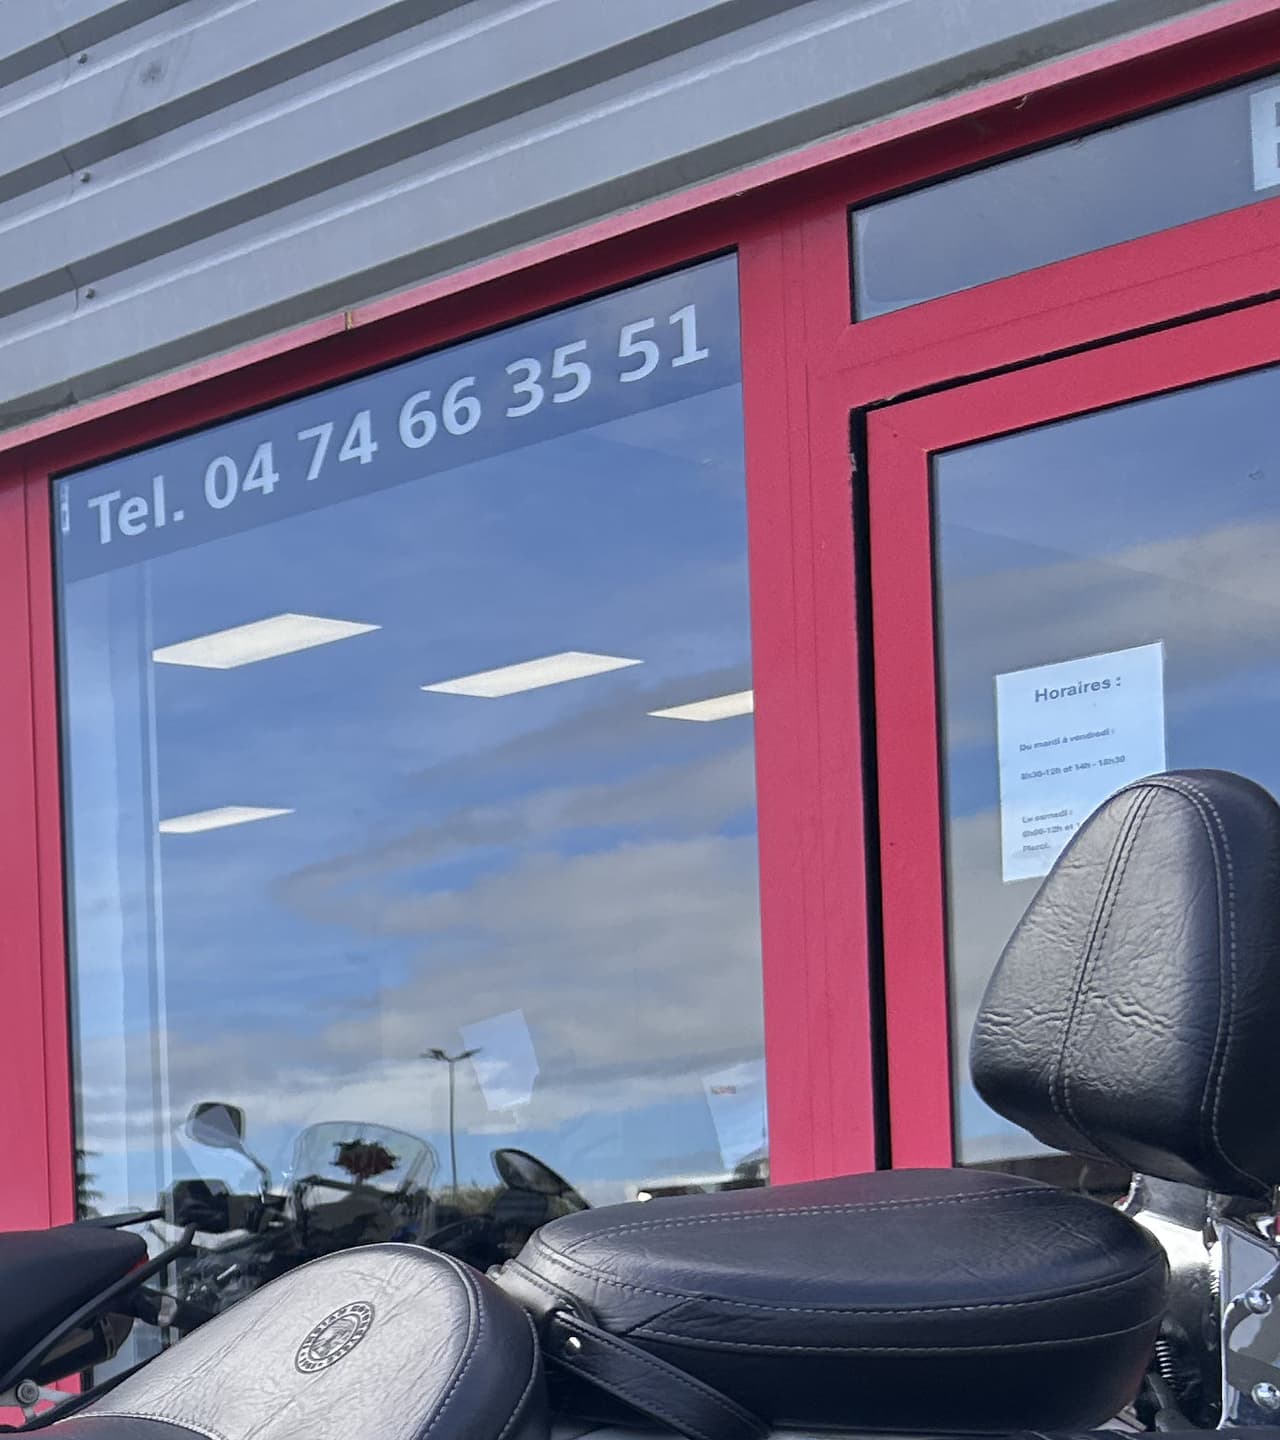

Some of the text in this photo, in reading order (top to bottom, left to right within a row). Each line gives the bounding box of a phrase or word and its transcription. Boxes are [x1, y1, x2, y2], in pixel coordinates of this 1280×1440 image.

[88, 303, 710, 545] Tel. 04 74 66 35 51
[1034, 679, 1112, 703] Horaires
